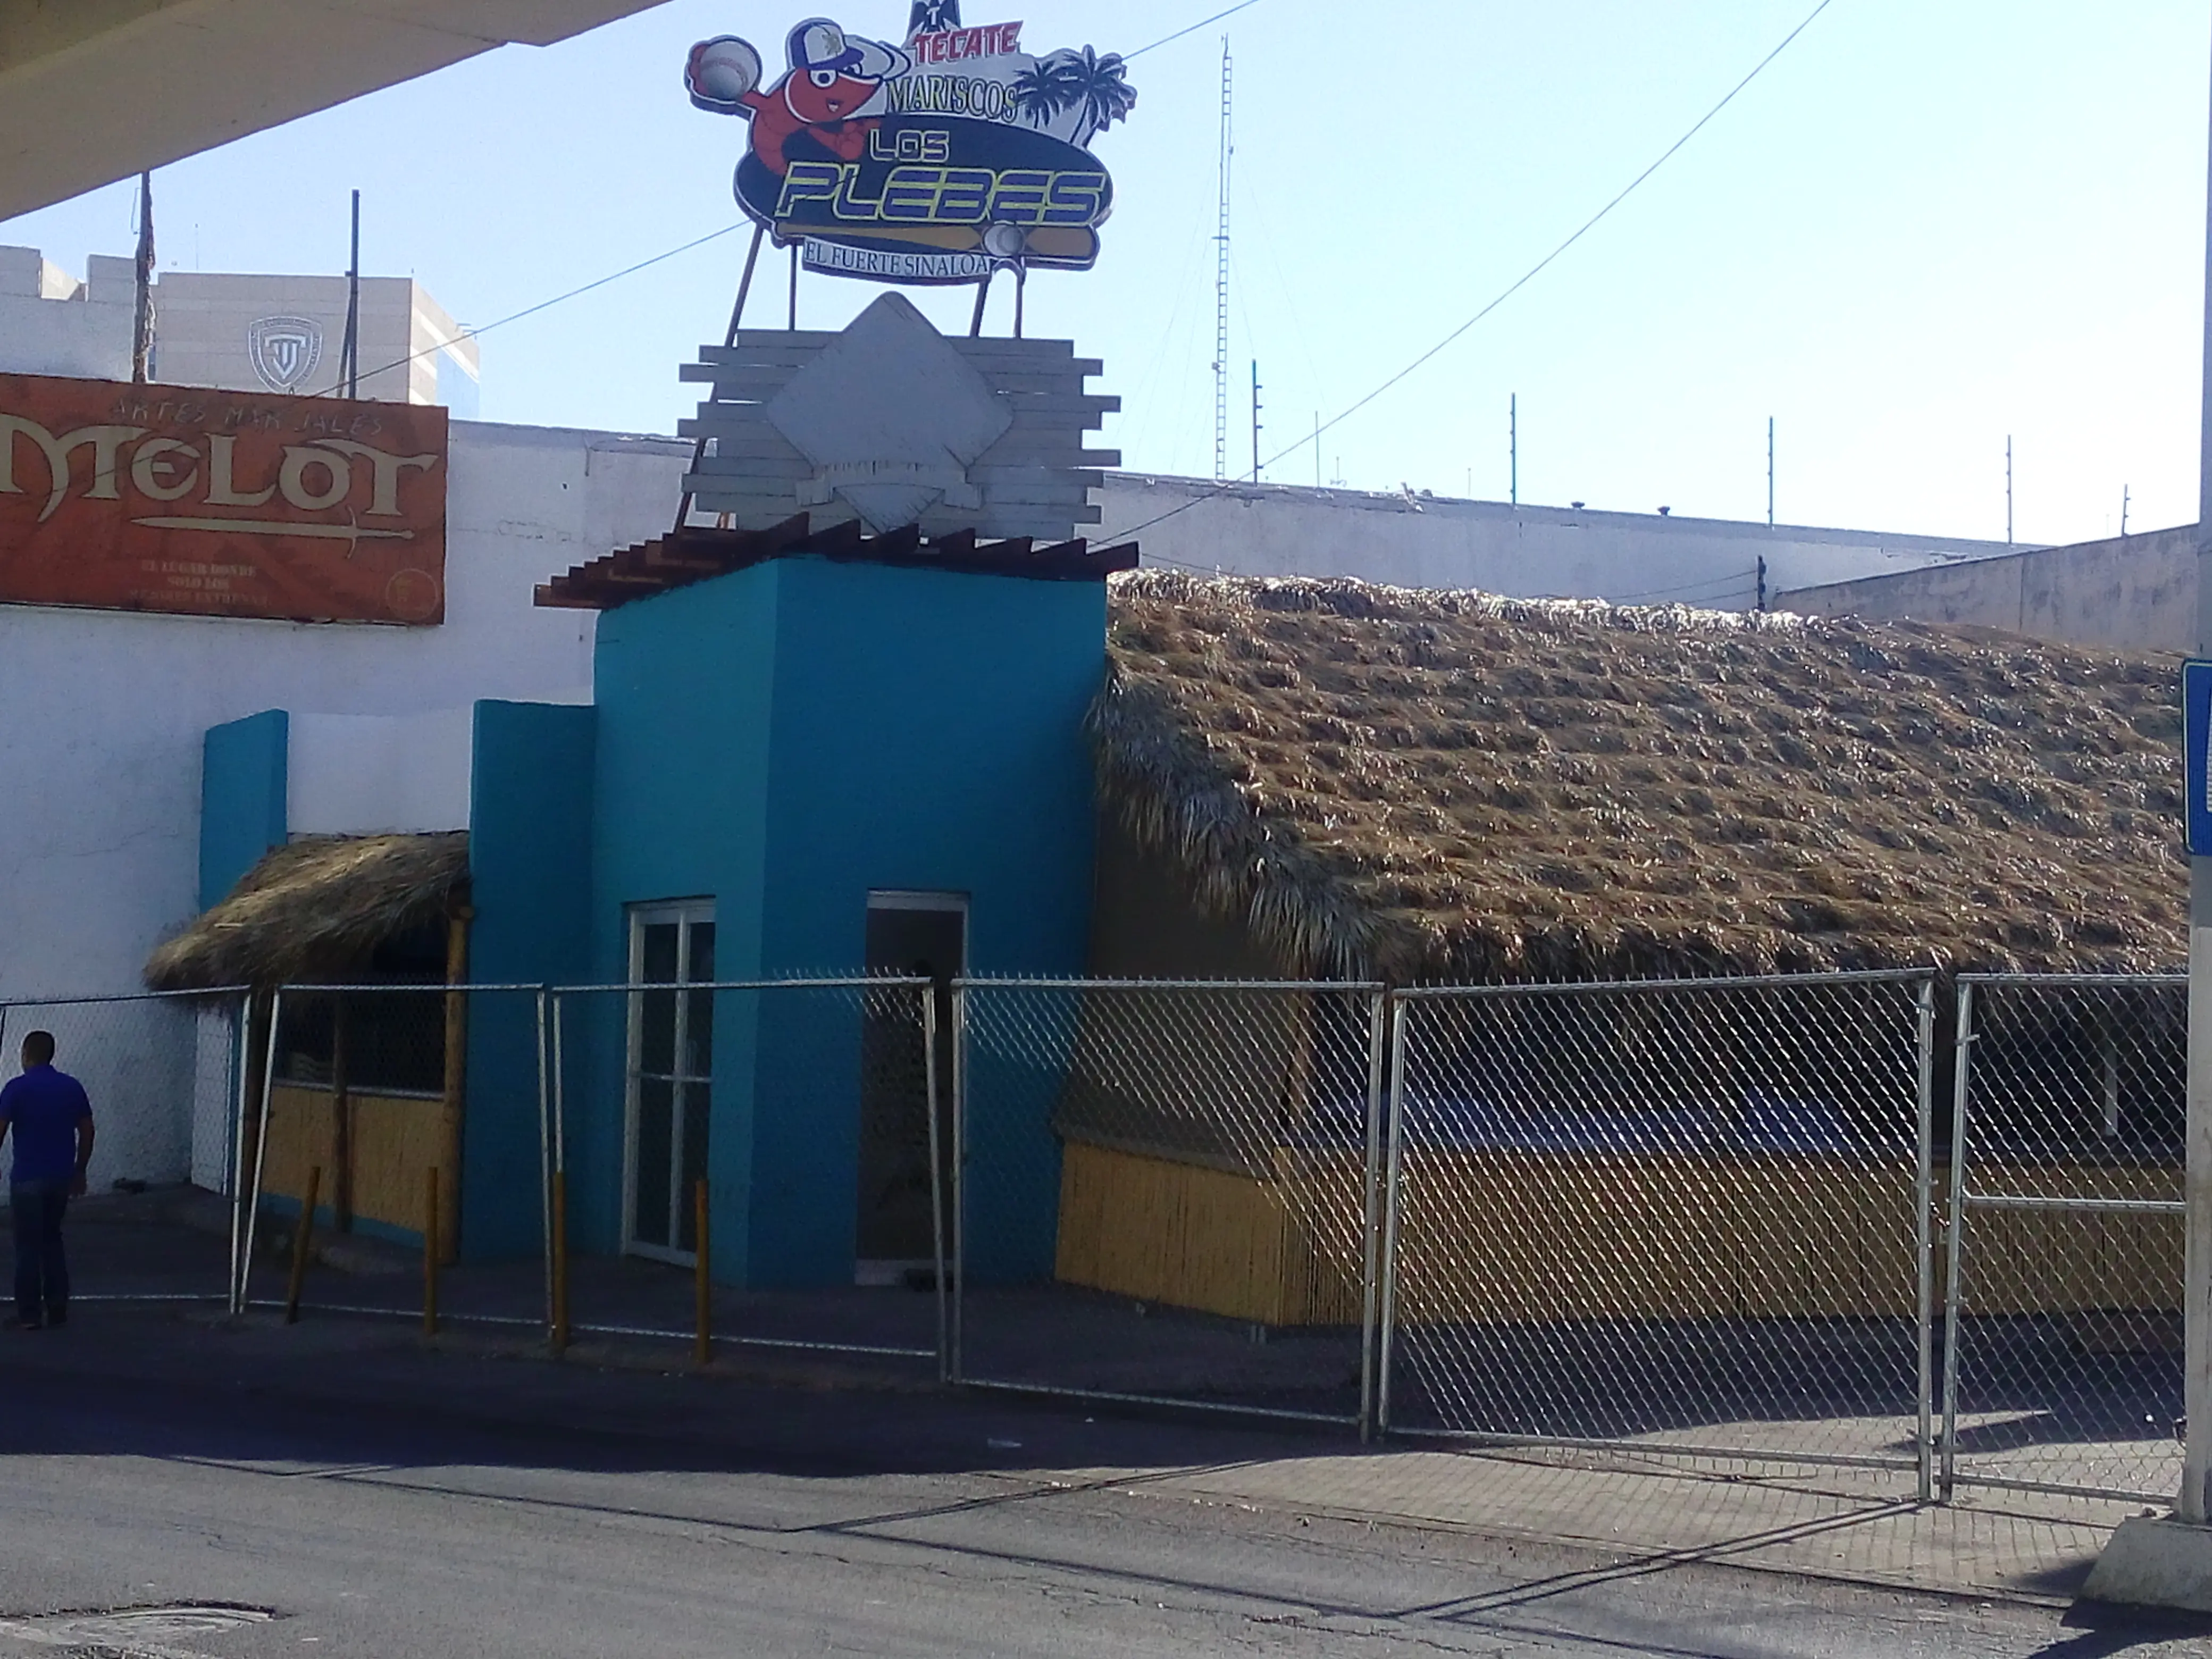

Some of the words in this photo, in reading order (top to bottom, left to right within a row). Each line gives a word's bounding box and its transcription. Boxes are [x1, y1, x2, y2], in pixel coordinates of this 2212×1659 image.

[914, 22, 1020, 64] TECATE
[887, 74, 1018, 122] MARISCOS
[870, 129, 950, 163] LOS
[774, 161, 1107, 226] PLEBES
[805, 241, 827, 263] EL
[832, 245, 901, 274] FUERTE
[904, 254, 988, 276] SINALOA
